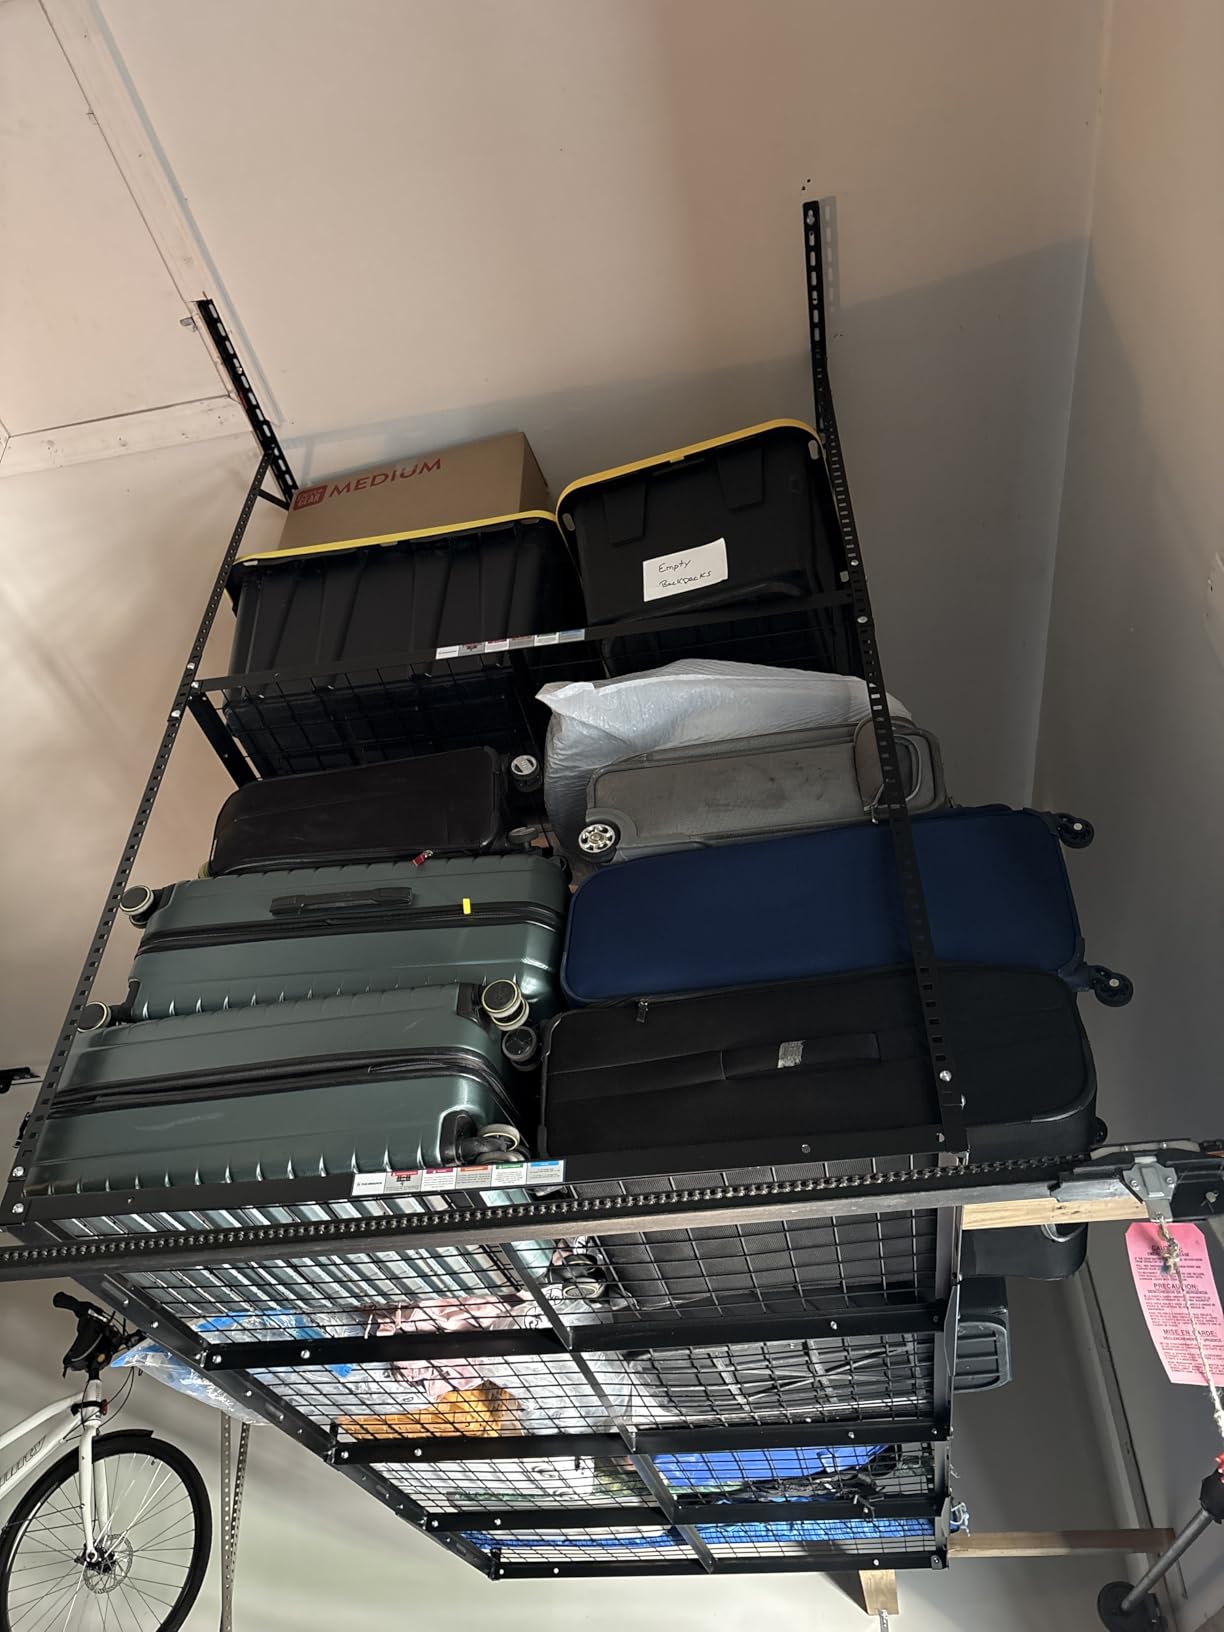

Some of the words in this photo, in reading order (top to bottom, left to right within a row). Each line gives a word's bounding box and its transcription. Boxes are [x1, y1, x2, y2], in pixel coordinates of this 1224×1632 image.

[329, 459, 441, 497] MEDIUM
[658, 560, 692, 572] Empty
[1153, 1282, 1199, 1290] PRECAUION:
